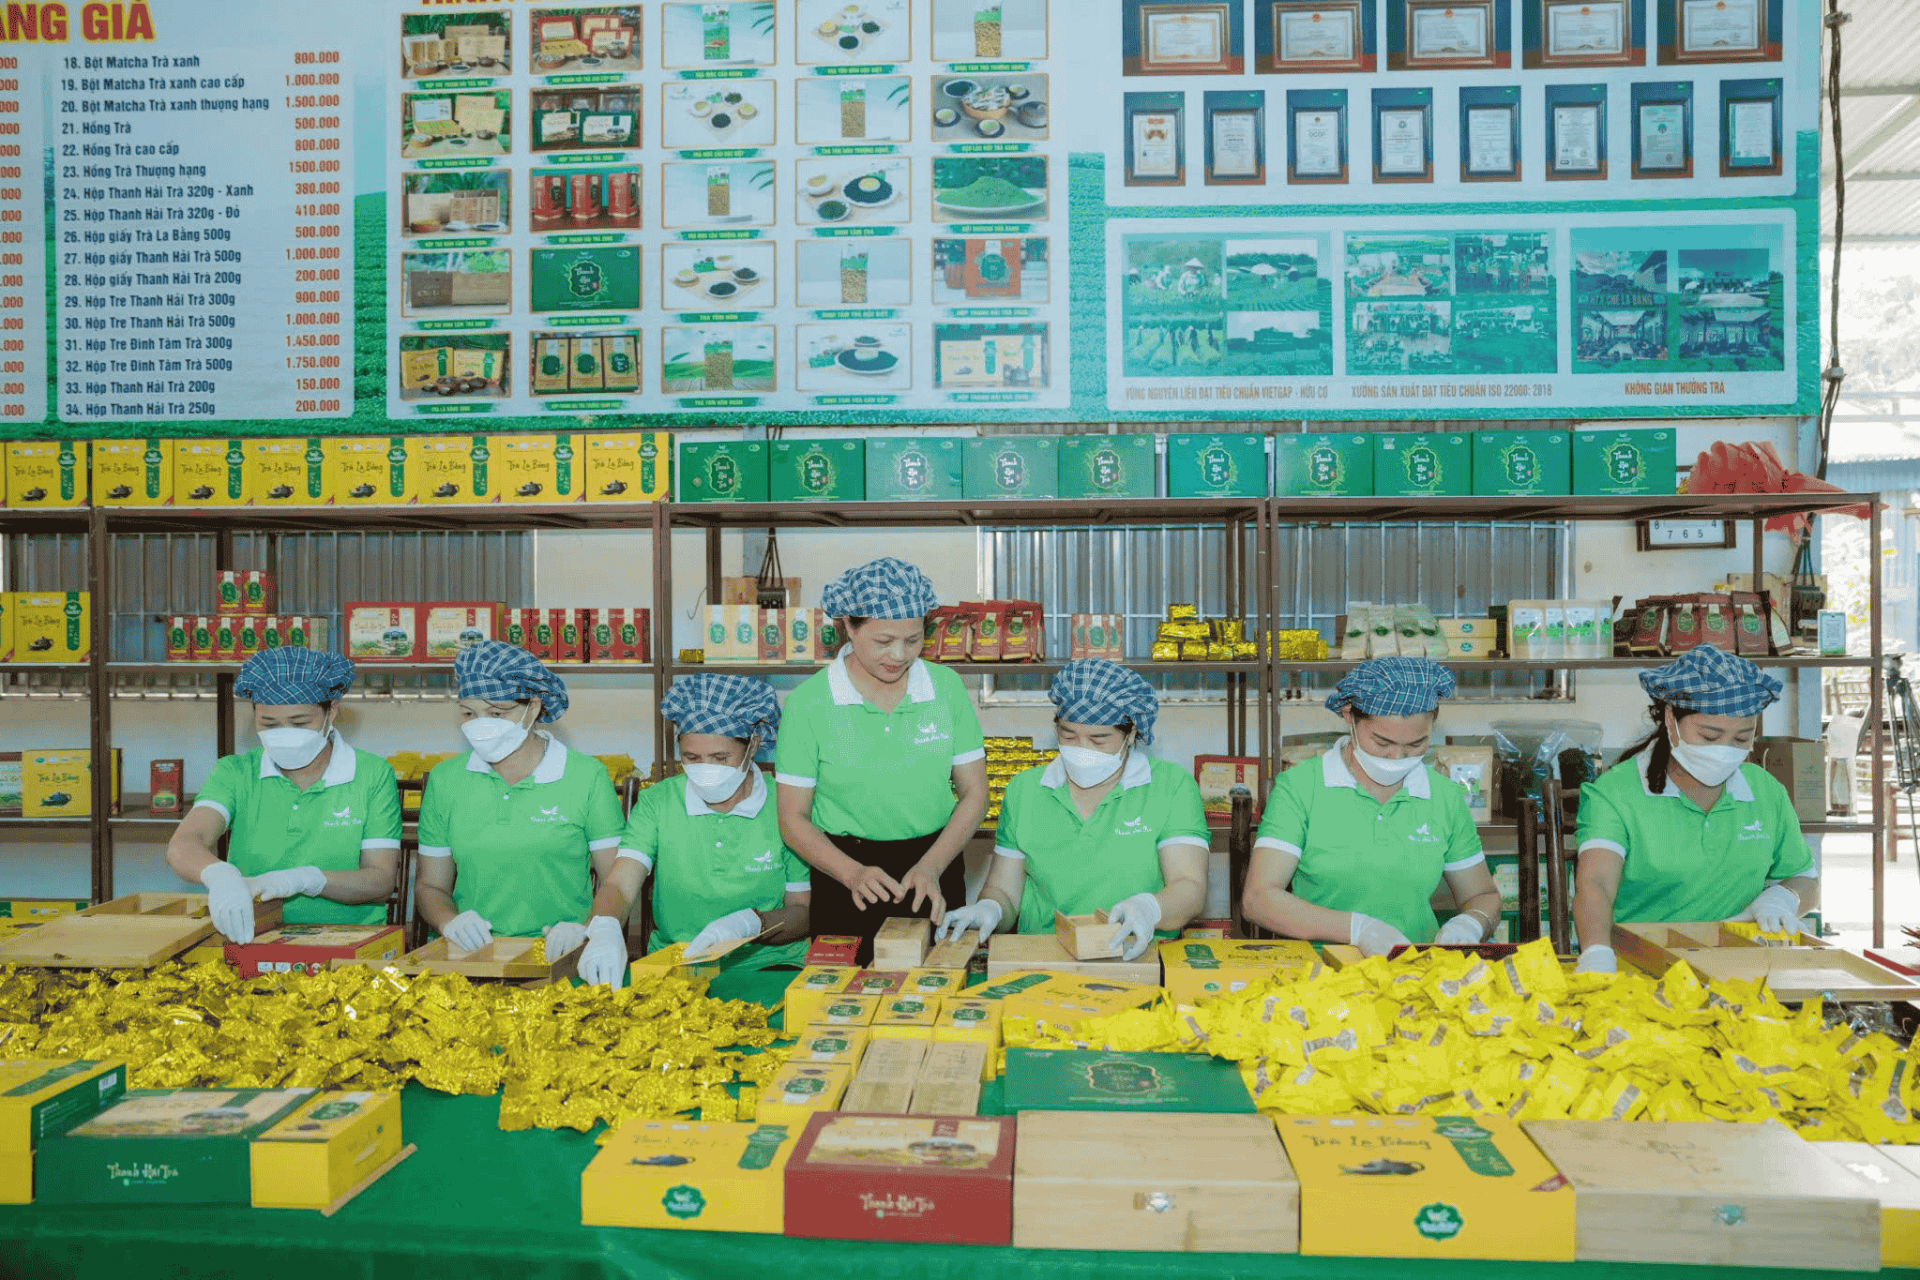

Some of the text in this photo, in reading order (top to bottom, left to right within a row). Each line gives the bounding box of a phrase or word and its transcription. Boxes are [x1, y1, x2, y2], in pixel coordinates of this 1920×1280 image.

[0, 2, 65, 40] NG
[63, 55, 81, 70] 18.
[105, 55, 149, 69] Matcha
[151, 54, 170, 69] Trà
[172, 54, 201, 69] xanh
[294, 50, 340, 65] 800.000
[61, 78, 78, 92] 19.
[102, 77, 146, 91] Matcha
[148, 76, 167, 91] Trà
[169, 76, 198, 90] xanh
[199, 77, 221, 90] cao
[285, 72, 340, 87] 1.000.000
[60, 99, 78, 114] 20.
[103, 99, 146, 113] Matcha
[148, 98, 167, 112] Trà
[169, 98, 198, 112] xanh
[285, 93, 340, 108] 1.500.000
[61, 121, 79, 136] 21.
[113, 121, 132, 135] Trà
[295, 116, 340, 130] 500.000
[62, 143, 80, 157] 22.
[114, 142, 132, 156] Trà
[134, 144, 156, 156] cao
[295, 137, 340, 152] 800.000
[62, 165, 80, 179] 23.
[114, 164, 133, 178] Trà
[62, 187, 80, 201] 24.
[83, 186, 105, 202] Hộp
[108, 186, 142, 200] Thanh
[166, 185, 184, 199] Trà
[186, 184, 215, 200] 320g
[225, 183, 254, 198] Xanh
[295, 181, 340, 196] 380.000
[63, 208, 80, 222] 25.
[83, 208, 106, 224] Hộp
[108, 208, 143, 222] Thanh
[166, 207, 184, 220] Trà
[186, 206, 215, 221] 320g
[295, 202, 340, 217] 410.000
[63, 230, 81, 244] 26.
[83, 230, 106, 246] Hộp
[135, 229, 153, 243] Trà
[155, 229, 169, 243] La
[203, 227, 231, 242] 500g
[295, 224, 340, 239] 500.000
[63, 252, 82, 266] 27.
[84, 251, 106, 267] Hộp
[135, 250, 170, 264] Thanh
[193, 249, 212, 263] Trà
[213, 249, 242, 264] 500g
[286, 246, 340, 261] 1.000.000
[64, 338, 82, 352] 31.
[85, 338, 107, 353] Hộp
[109, 337, 127, 351] Tre
[184, 336, 203, 350] Trà
[205, 335, 233, 351] 300g
[286, 333, 340, 347] 1.450.000
[65, 381, 83, 395] 33.
[85, 381, 107, 397] Hộp
[110, 380, 144, 394] Thanh
[167, 380, 185, 394] Trà
[187, 379, 216, 395] 200g
[296, 377, 341, 391] 150.000
[1488, 385, 1501, 397] ISO
[1654, 382, 1674, 395] GIAN
[65, 403, 83, 417] 34.
[85, 403, 107, 419] Hộp
[109, 402, 144, 416] Thanh
[167, 401, 185, 417] Trà
[188, 401, 216, 416] 250g
[295, 399, 340, 413] 200.000
[1654, 520, 1660, 530] 8
[1667, 530, 1673, 539] 7
[1683, 530, 1689, 539] 6
[1698, 529, 1704, 539] 5
